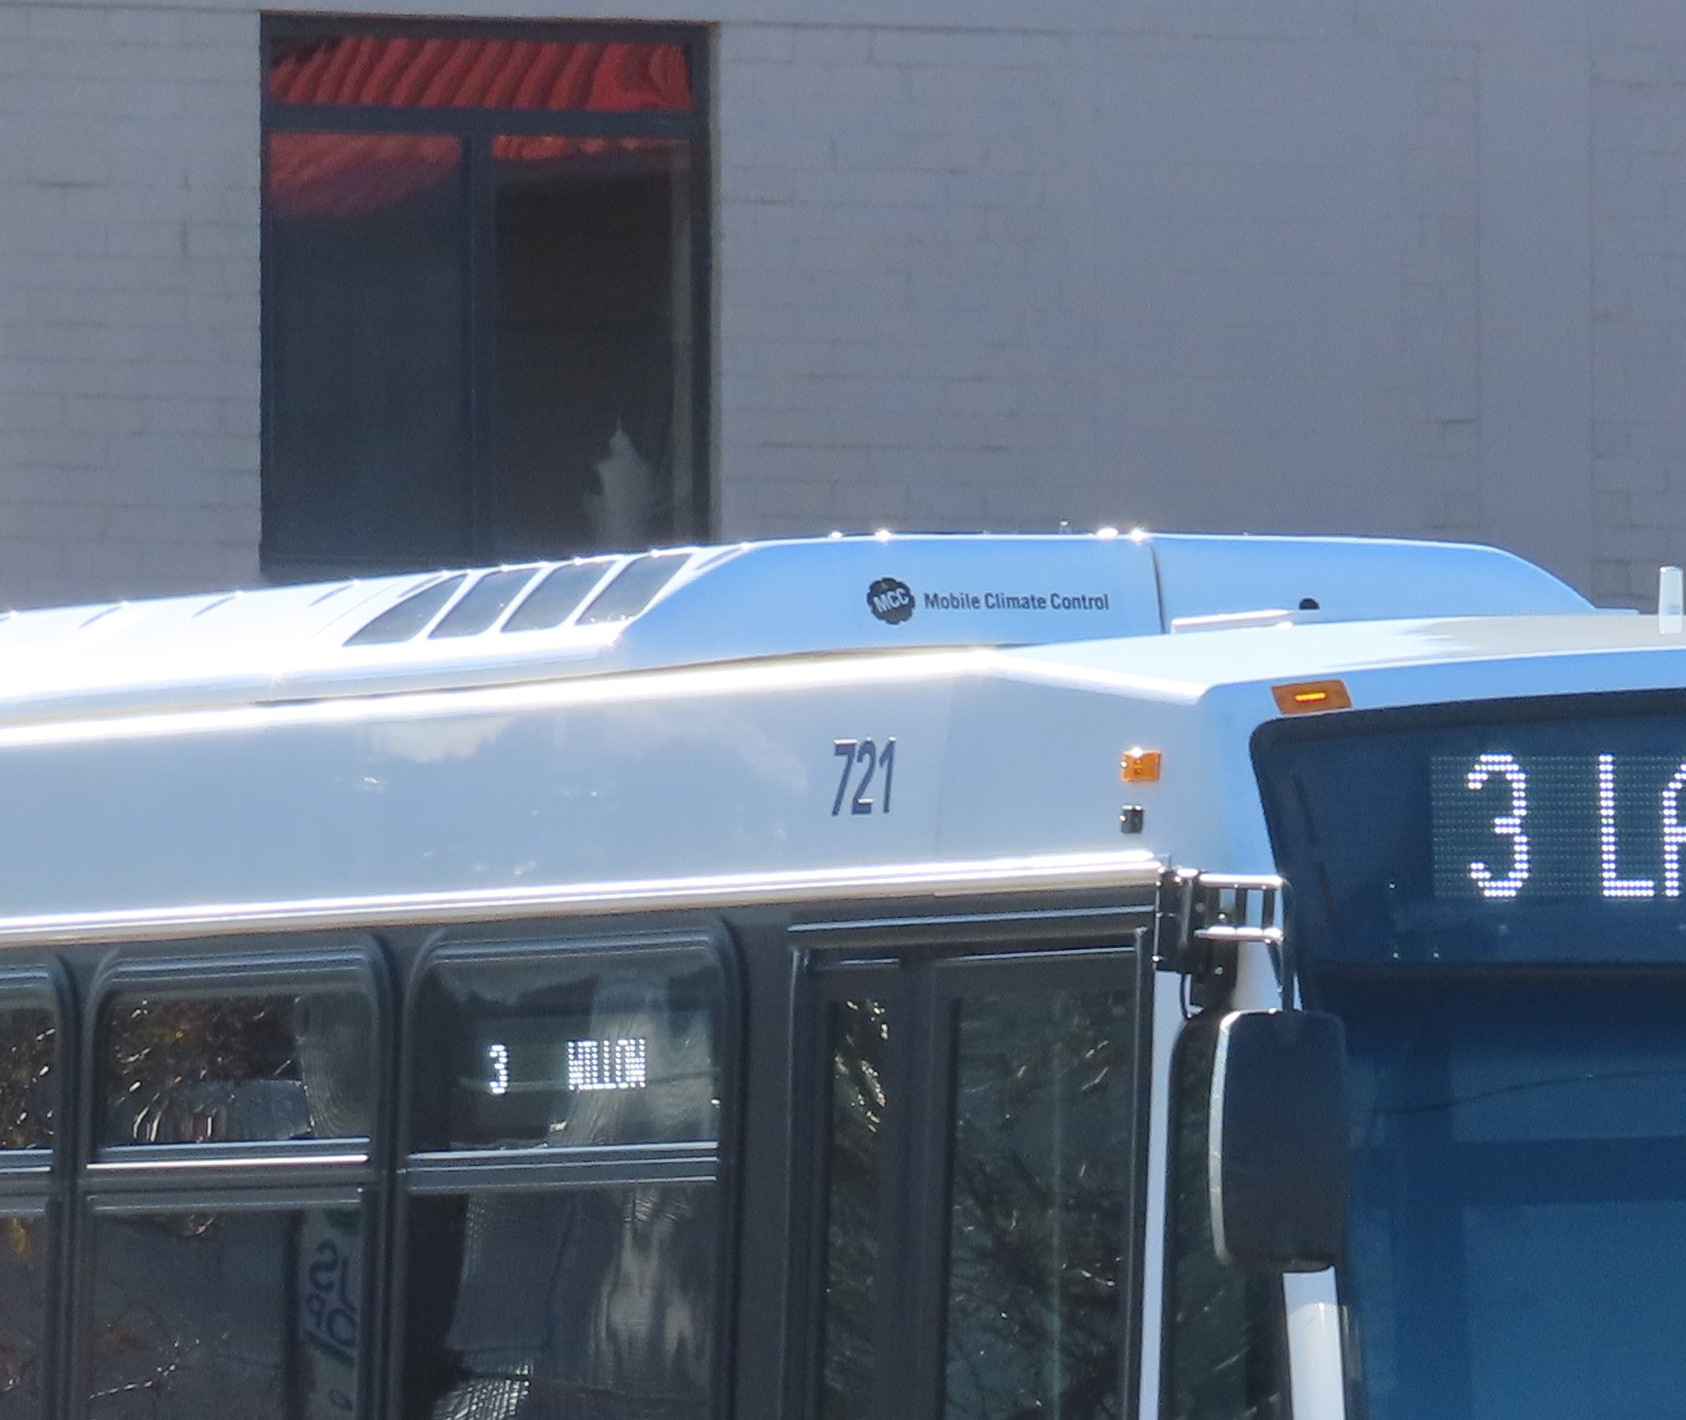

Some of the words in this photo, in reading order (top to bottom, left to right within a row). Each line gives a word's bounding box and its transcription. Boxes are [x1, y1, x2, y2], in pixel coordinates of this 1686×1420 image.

[872, 587, 911, 614] MCC
[923, 592, 982, 611] Mobile
[984, 592, 1048, 611] Climate
[1050, 592, 1111, 612] Control
[831, 736, 897, 816] 721
[1461, 753, 1529, 899] 3
[489, 1044, 509, 1095] 3
